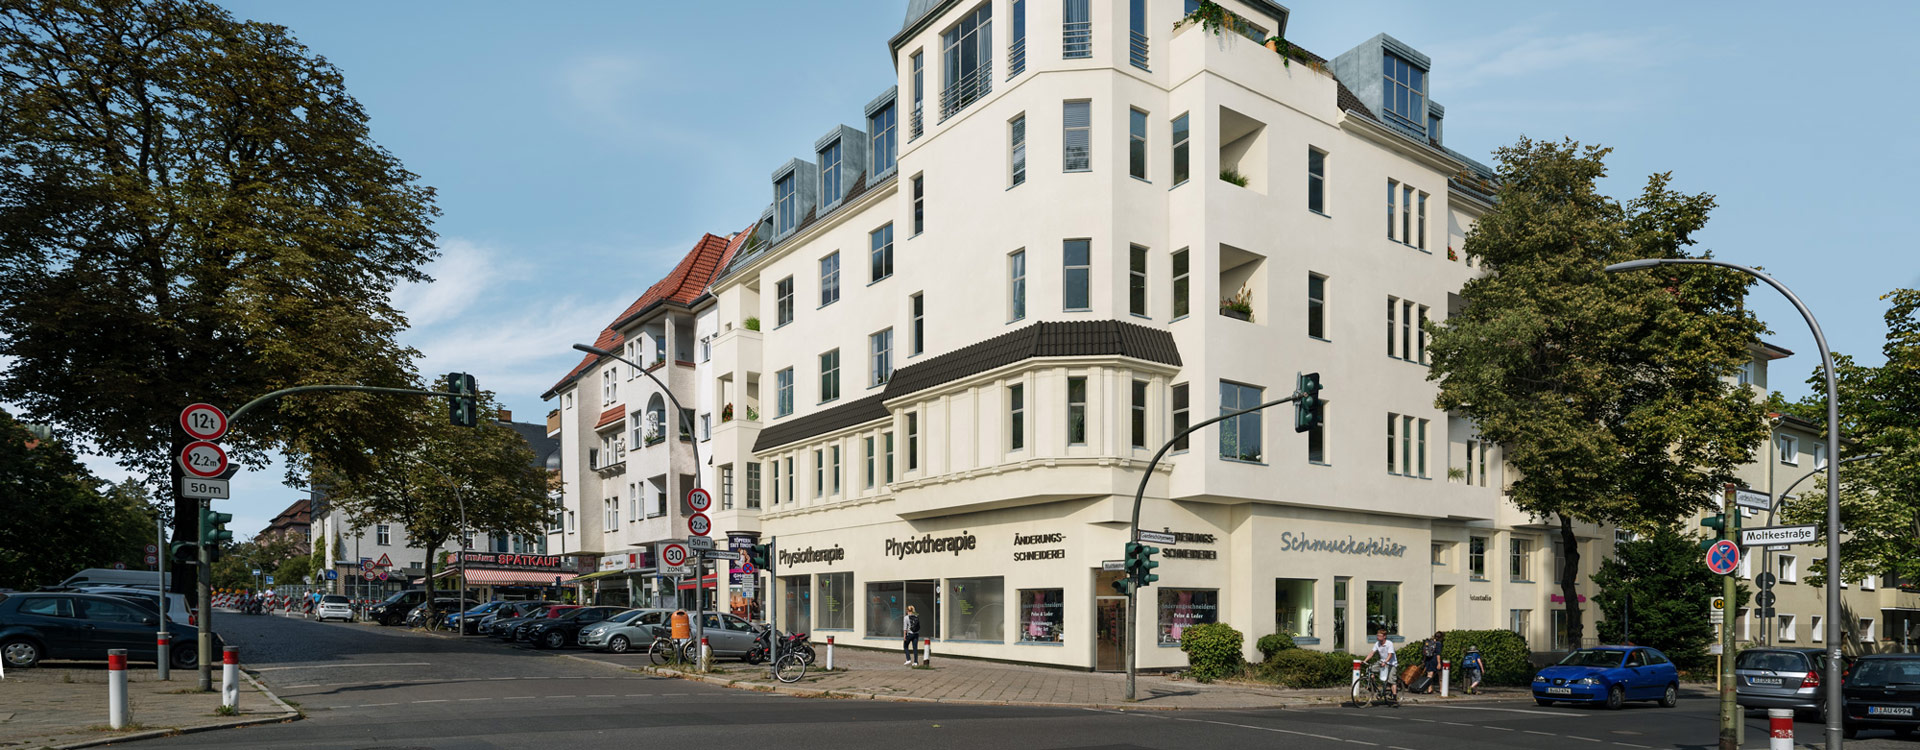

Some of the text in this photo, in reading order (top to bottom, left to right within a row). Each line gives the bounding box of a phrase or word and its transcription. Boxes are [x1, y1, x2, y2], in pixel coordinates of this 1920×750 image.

[191, 412, 215, 429] 12t
[191, 482, 221, 494] 50 m
[693, 494, 705, 505] 12t
[1014, 533, 1067, 546] ÄNDERUNGS-
[1746, 529, 1811, 541] Moltkestraße
[693, 538, 700, 546] 50
[885, 530, 976, 560] Physiotherapie
[1281, 531, 1407, 557] Schmuckatelier
[461, 553, 495, 563] ETRÄNKE
[668, 550, 681, 560] 30
[779, 543, 844, 568] Physiotherapie
[1014, 549, 1065, 561] SCHNEIDEREI
[1162, 548, 1217, 560] SCHNEIDEREI
